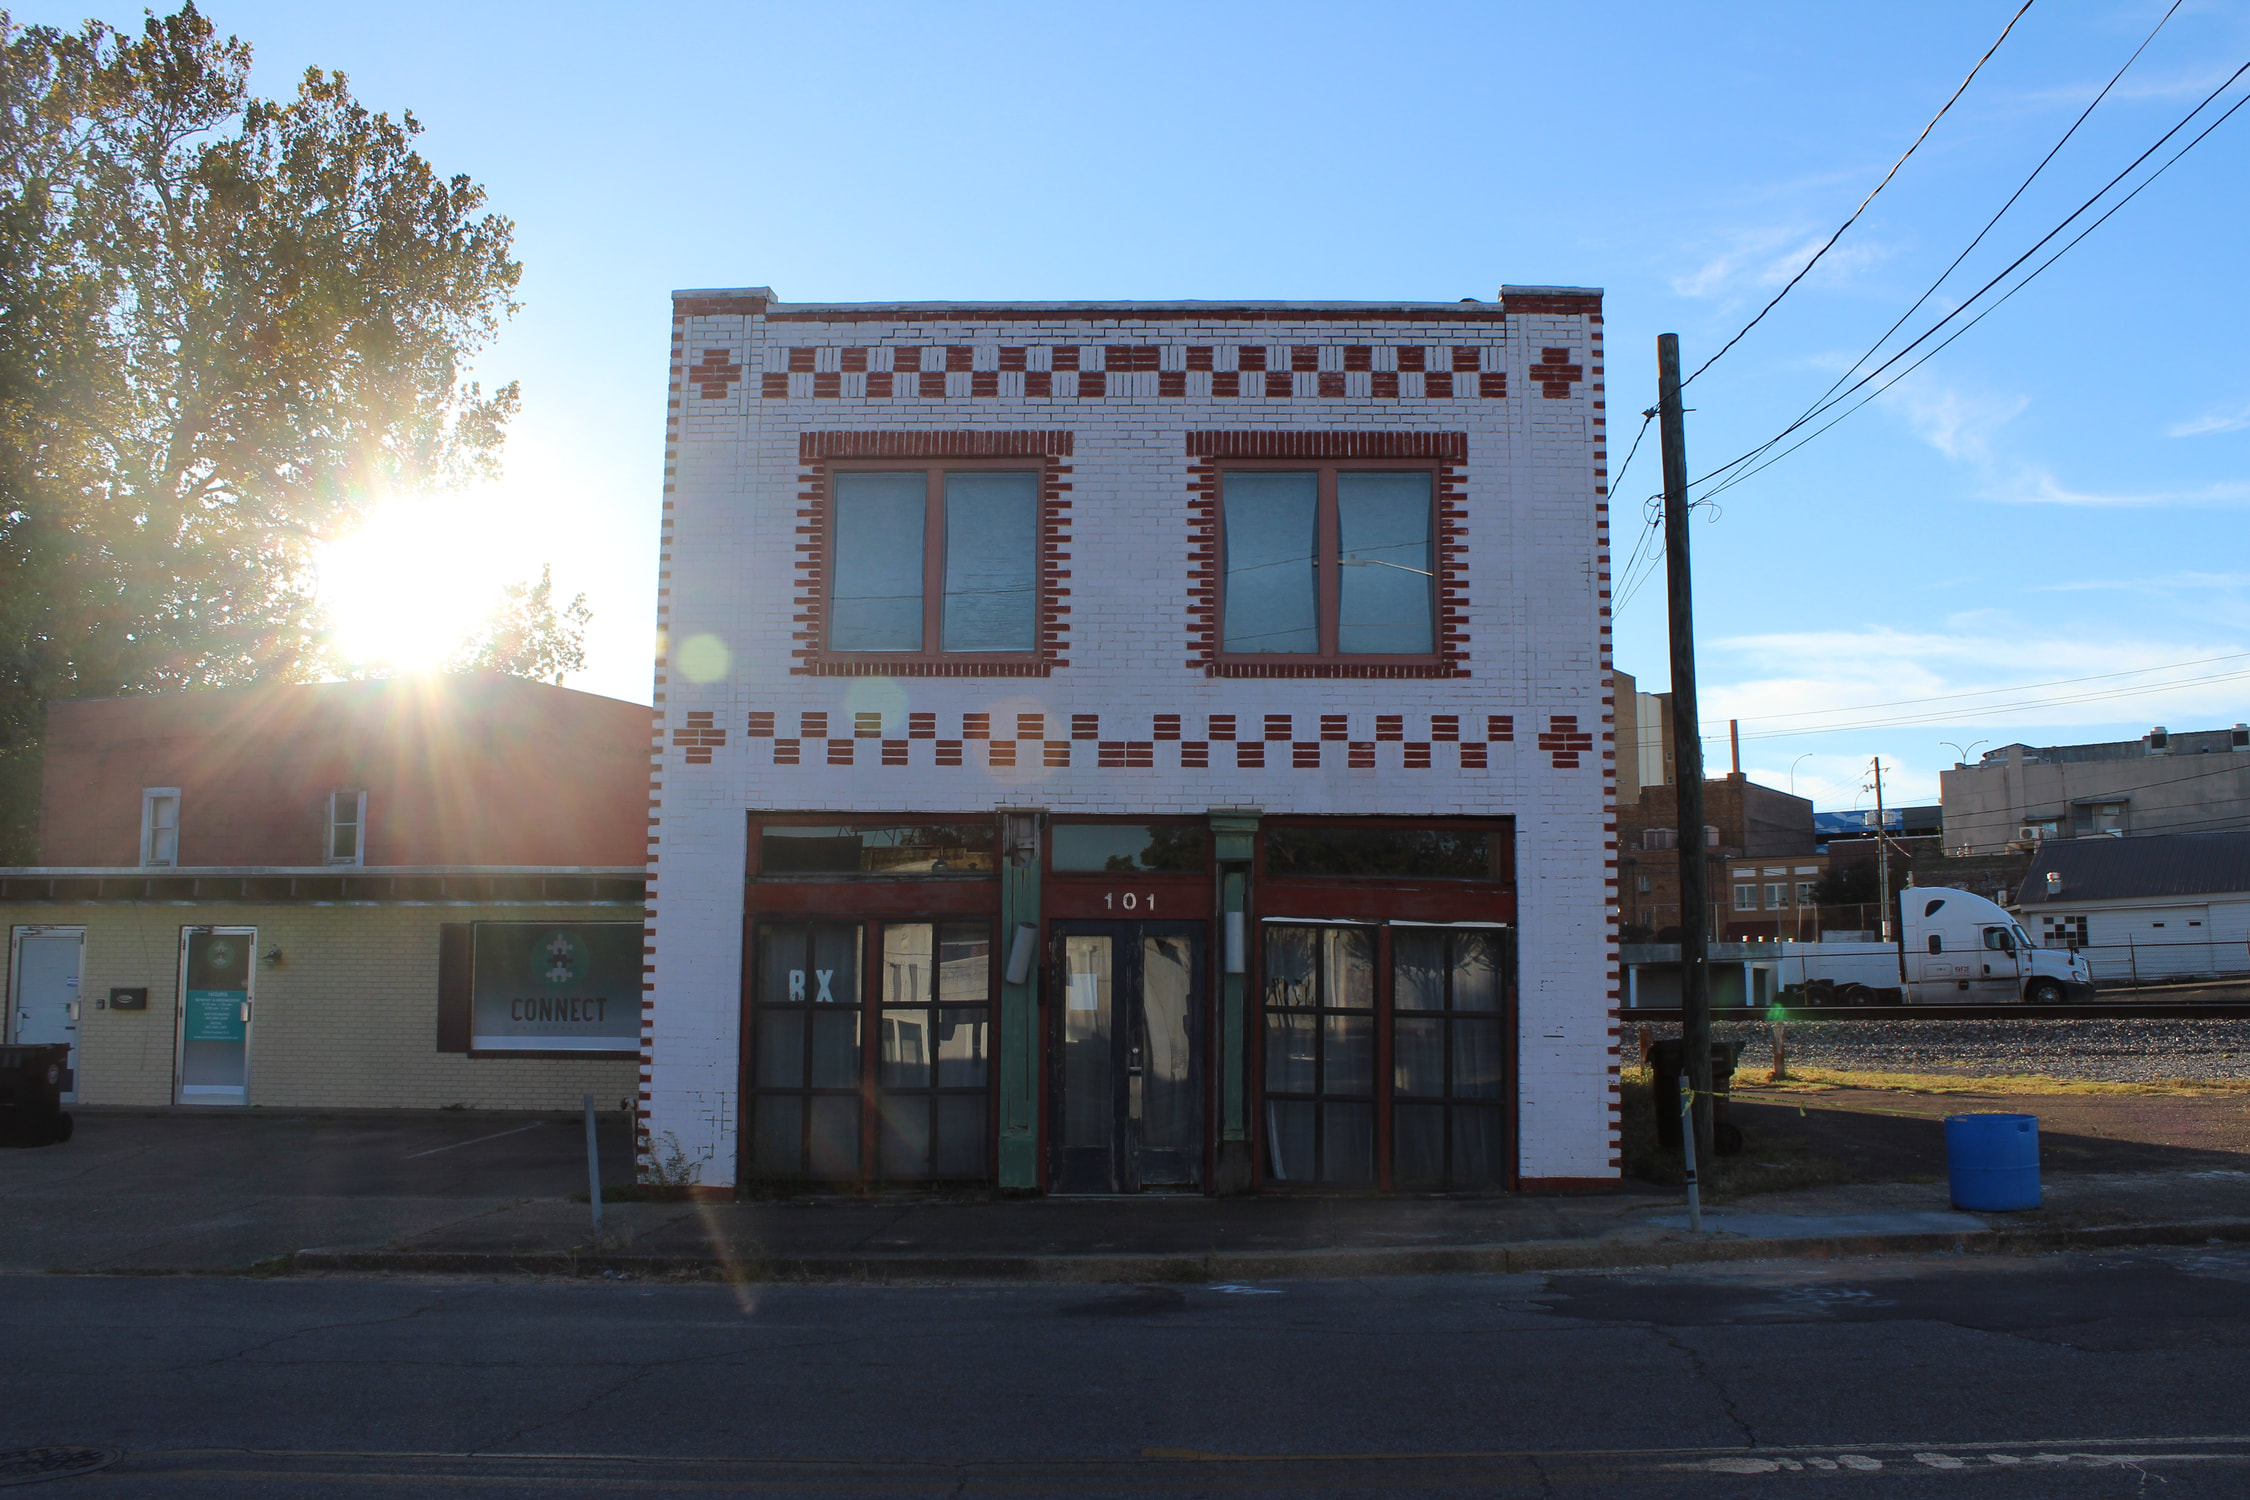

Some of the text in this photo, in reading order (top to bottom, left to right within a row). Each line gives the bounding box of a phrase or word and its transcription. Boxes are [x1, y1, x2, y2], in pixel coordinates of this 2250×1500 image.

[1104, 892, 1155, 911] 101
[789, 969, 834, 1003] RX
[512, 998, 608, 1021] CONNECT
